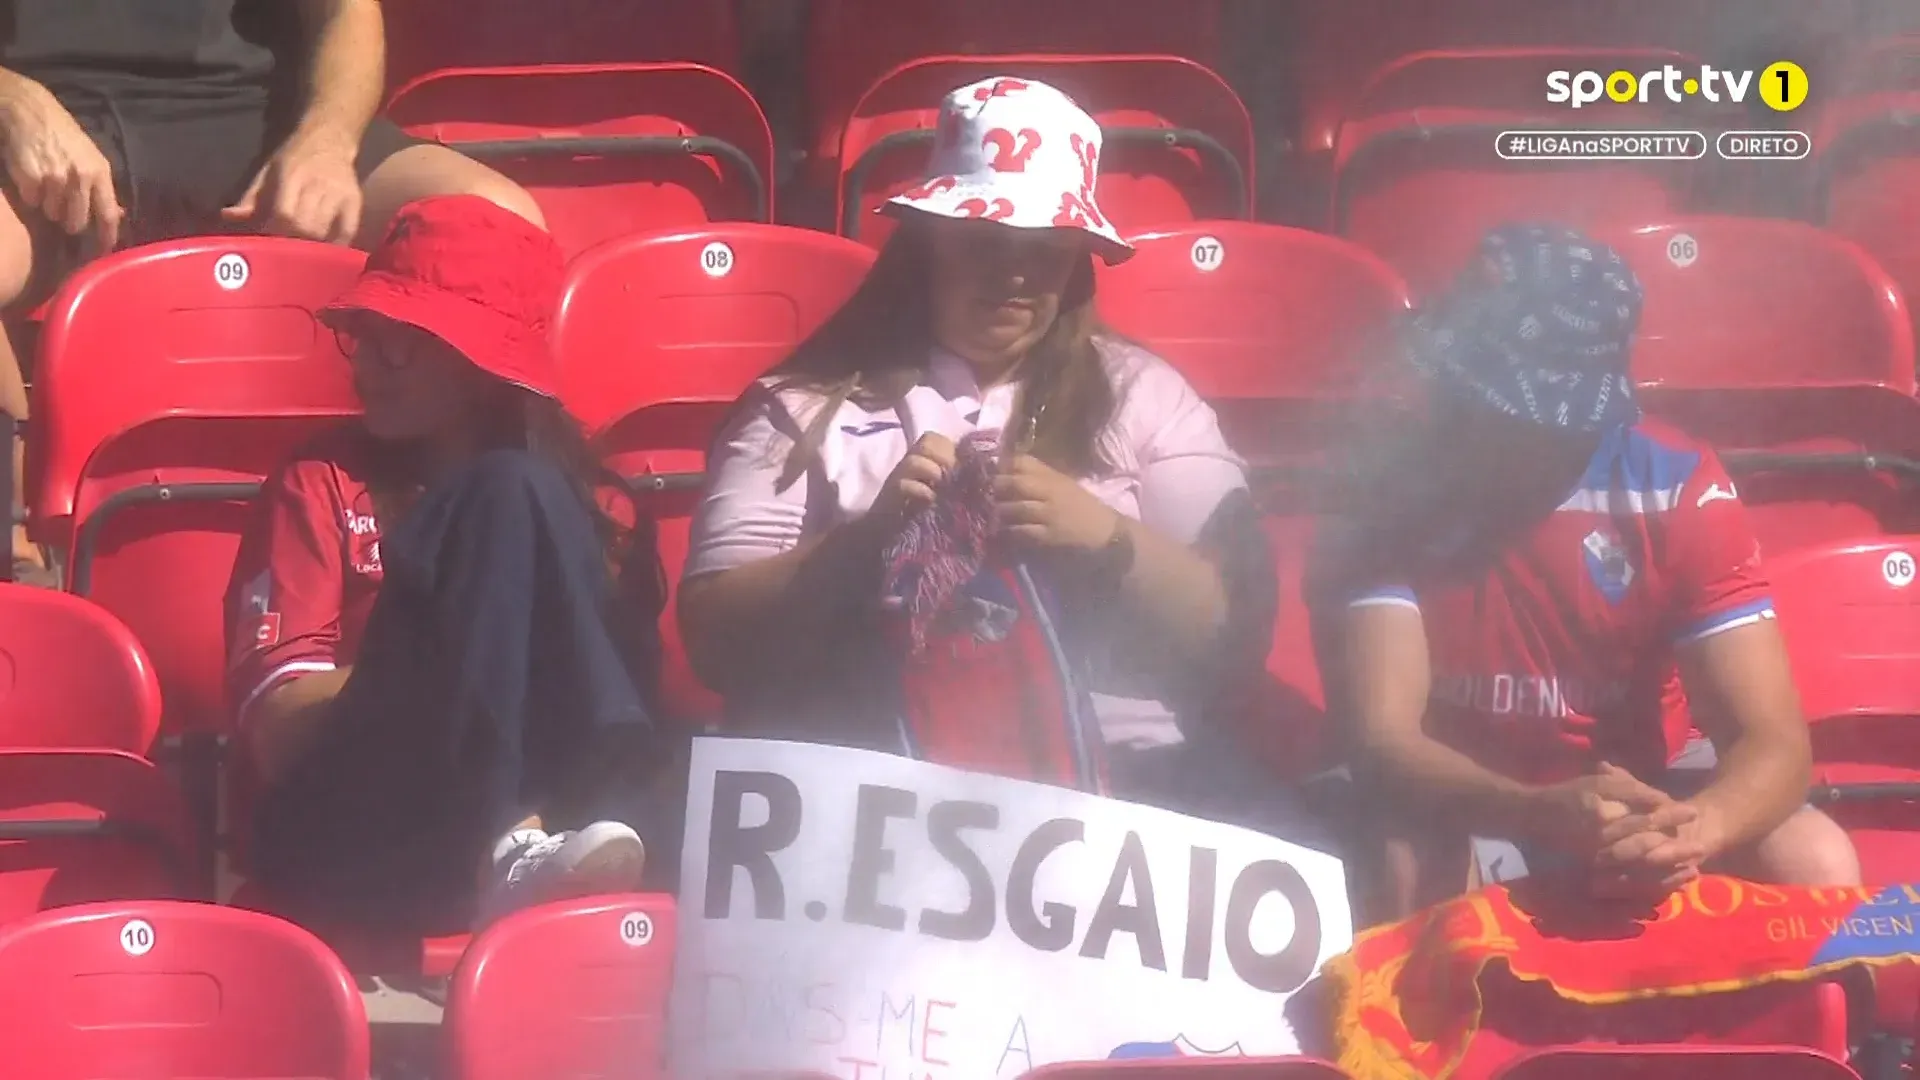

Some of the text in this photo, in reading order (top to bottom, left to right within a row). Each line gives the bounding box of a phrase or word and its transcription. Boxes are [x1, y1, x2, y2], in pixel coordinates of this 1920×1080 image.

[705, 249, 729, 269] 08
[1194, 244, 1219, 263] 07
[1669, 240, 1696, 260] 06
[219, 261, 244, 281] 09
[1886, 558, 1911, 579] 06
[624, 920, 649, 939] 09
[1766, 912, 1920, 942] GIL VICEN
[124, 927, 149, 948] 10
[995, 1014, 1034, 1077] A
